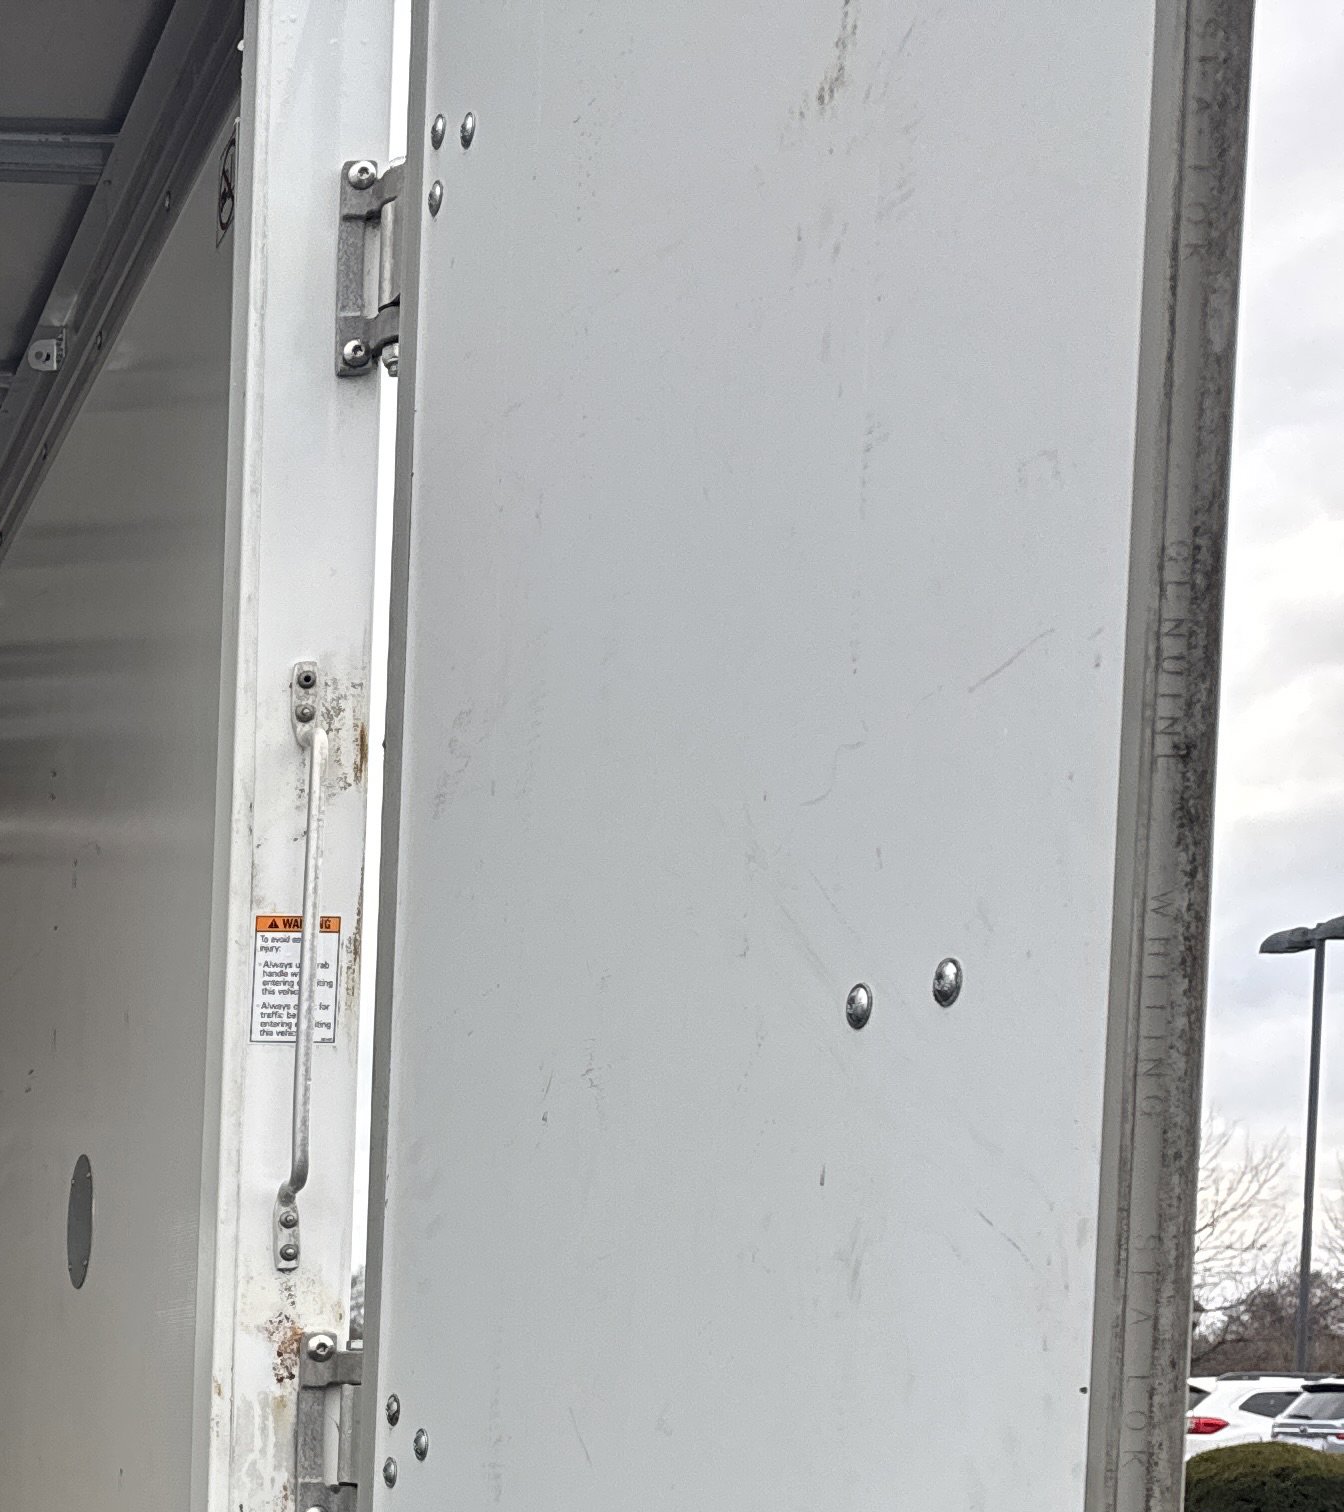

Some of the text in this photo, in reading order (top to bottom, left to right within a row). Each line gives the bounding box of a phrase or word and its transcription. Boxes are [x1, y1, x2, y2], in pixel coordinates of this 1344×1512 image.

[260, 935, 268, 943] To
[263, 960, 293, 970] Always
[261, 1002, 291, 1011] Always
